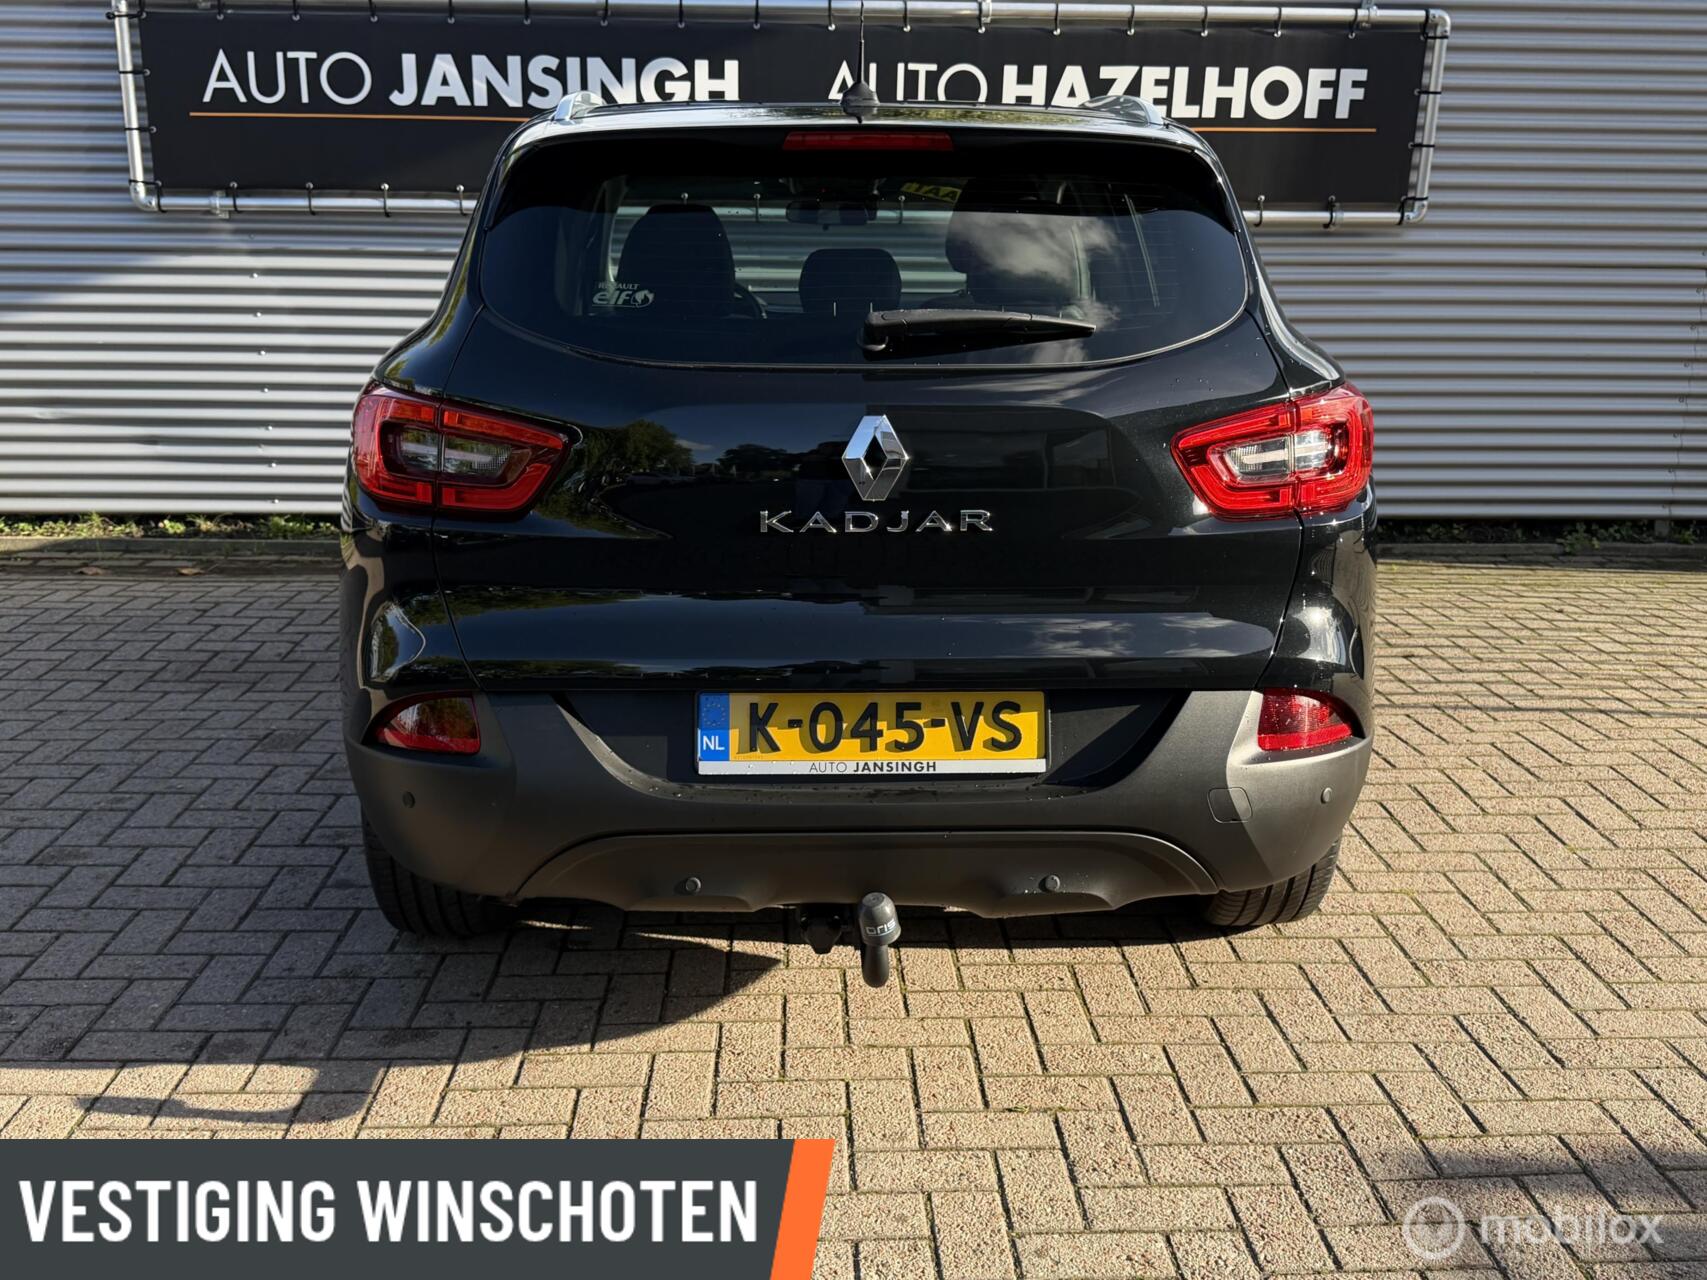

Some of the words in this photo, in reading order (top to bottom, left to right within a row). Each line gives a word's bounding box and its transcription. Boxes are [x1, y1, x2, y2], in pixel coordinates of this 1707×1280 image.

[202, 48, 372, 105] AUTO
[389, 52, 740, 109] JANSINGH
[828, 60, 989, 104] AUTO
[1001, 64, 1369, 120] HAZELHOFF
[592, 290, 633, 305] elf
[759, 509, 995, 533] KADJAR
[749, 700, 1023, 753] K-045-VS
[702, 734, 725, 752] NL
[808, 761, 848, 773] AUTO
[852, 760, 937, 773] JANSINGH
